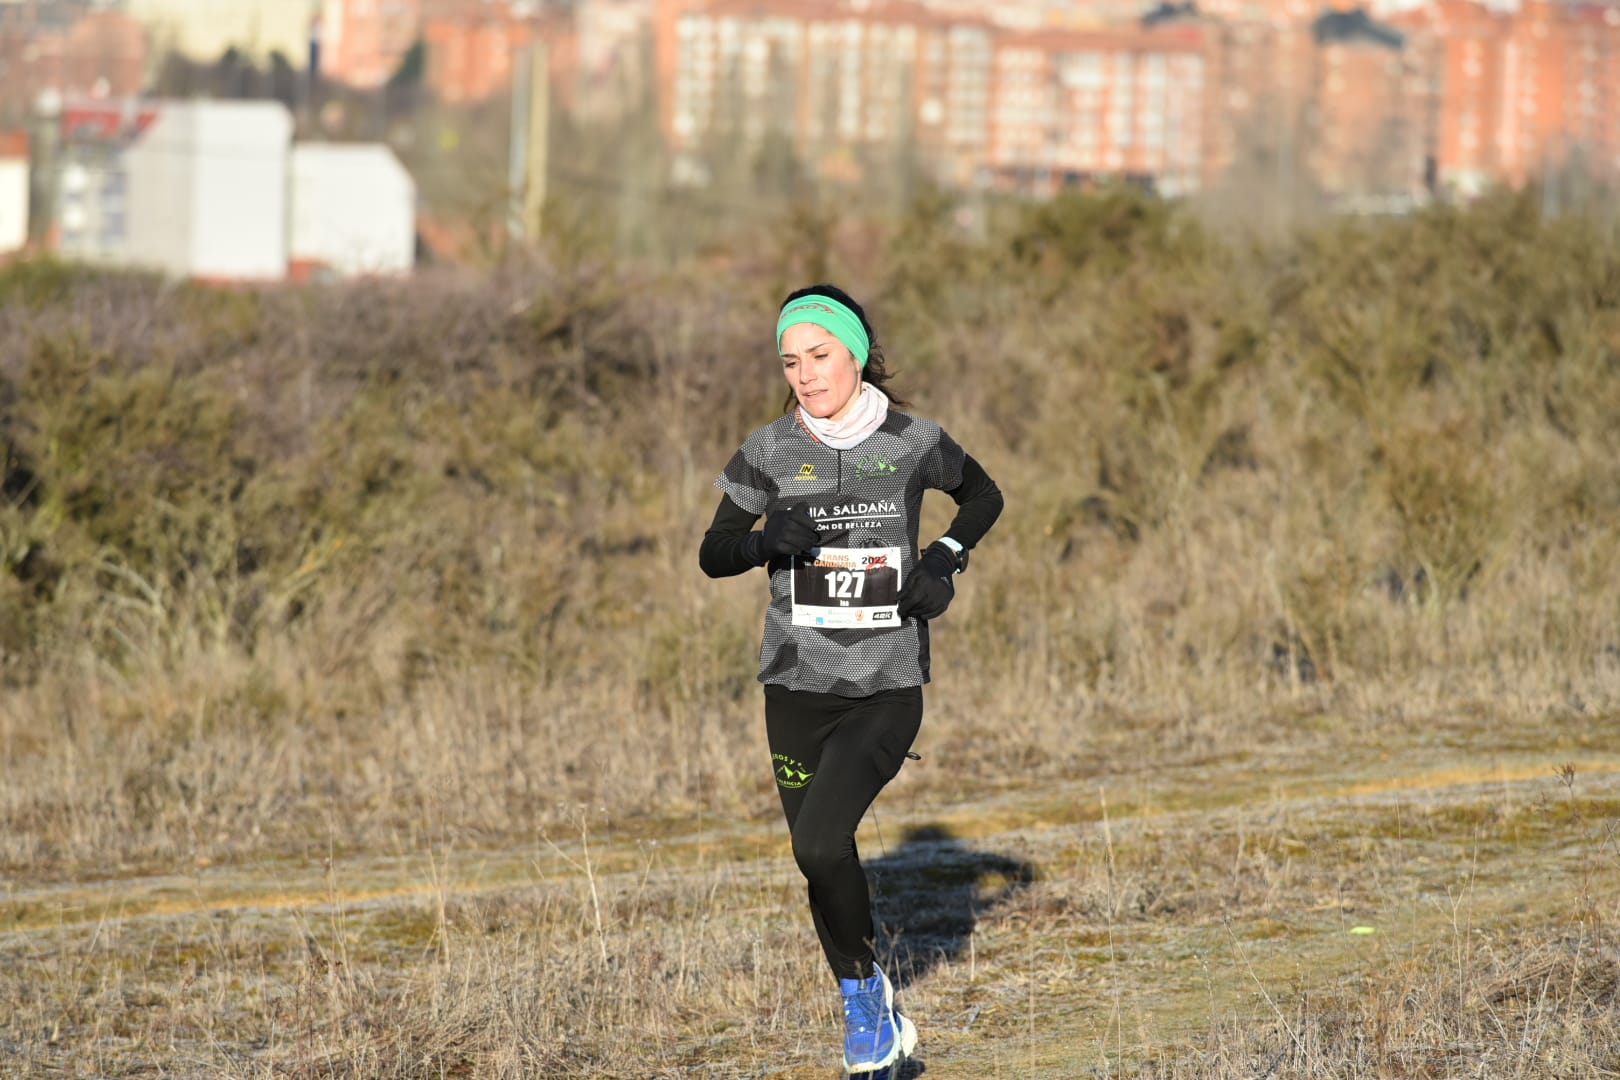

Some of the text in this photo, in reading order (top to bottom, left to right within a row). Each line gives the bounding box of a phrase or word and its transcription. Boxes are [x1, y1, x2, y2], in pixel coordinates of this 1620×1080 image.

[833, 500, 897, 516] SALDAÑA
[846, 521, 882, 529] BELLEZA
[861, 555, 888, 565] 2022
[824, 571, 866, 598] 127
